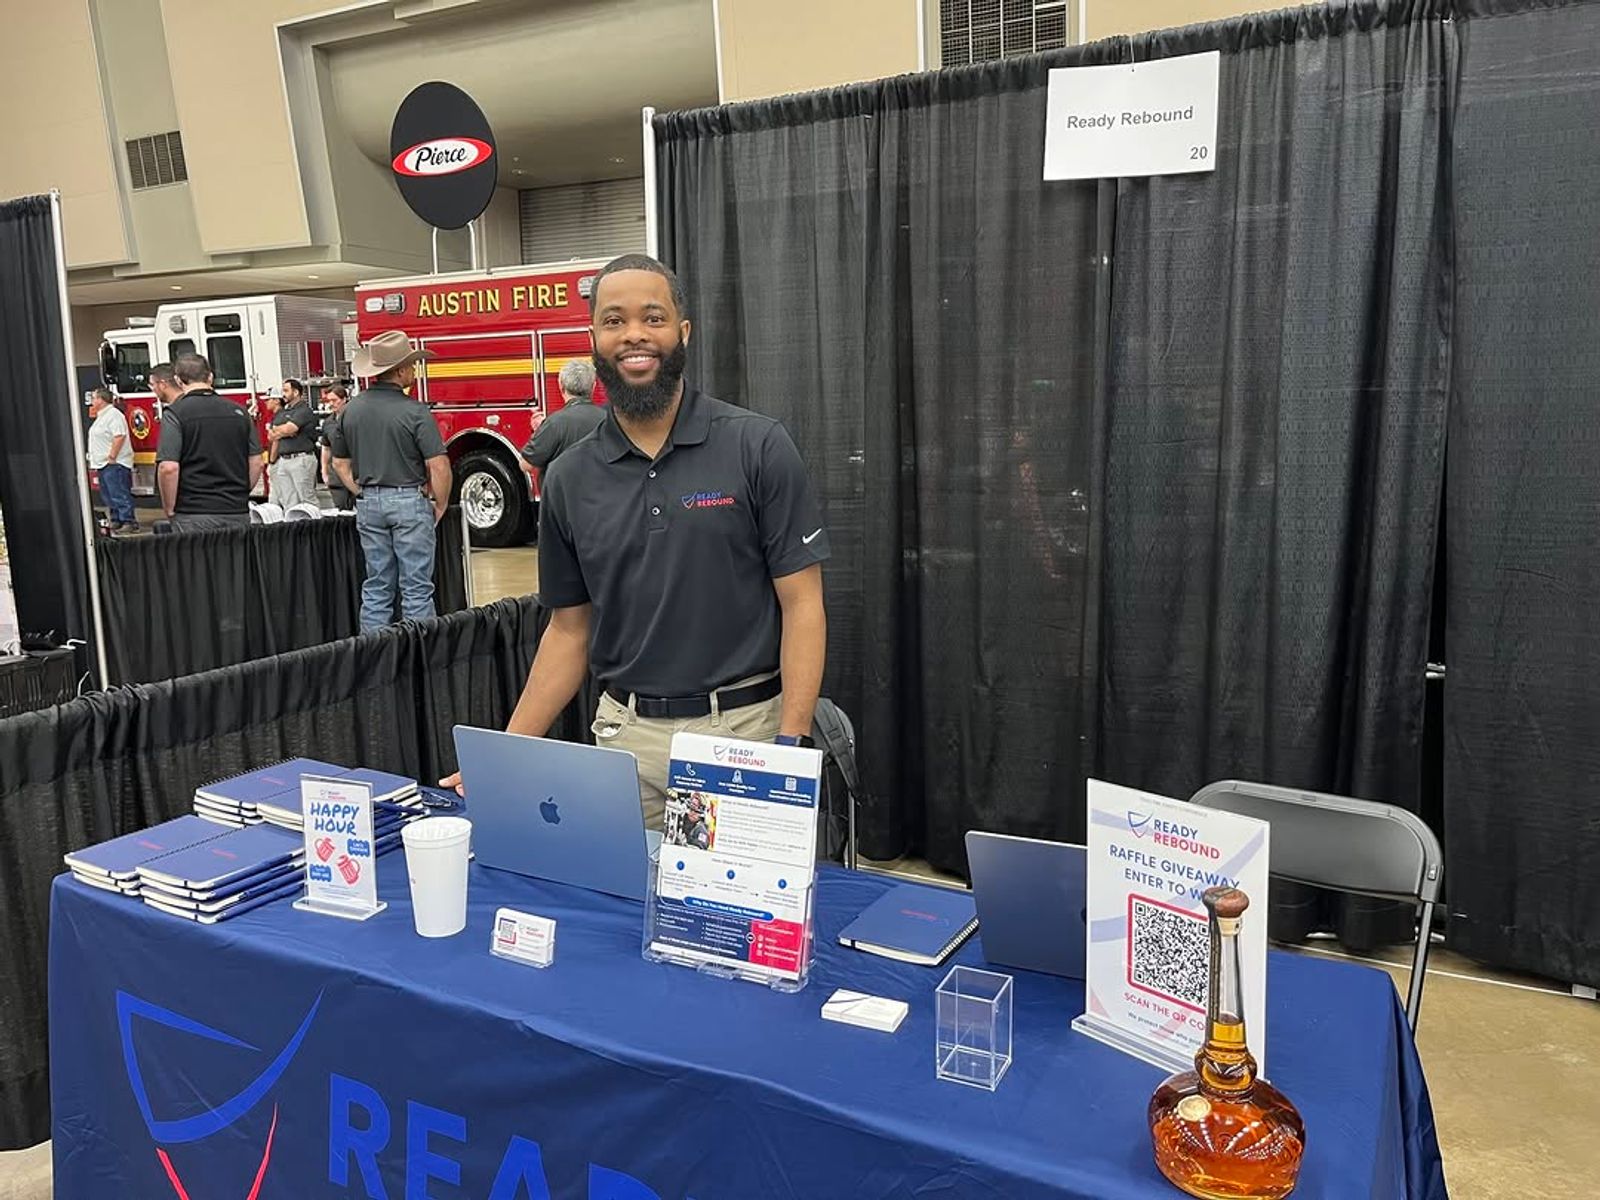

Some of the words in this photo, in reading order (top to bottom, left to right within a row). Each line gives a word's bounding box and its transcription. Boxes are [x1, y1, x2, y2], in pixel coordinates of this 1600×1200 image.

[1067, 113, 1116, 130] Ready
[1121, 106, 1194, 125] Rebound
[414, 146, 468, 171] Pierce
[1189, 146, 1208, 160] 20
[417, 289, 500, 318] AUSTIN
[512, 283, 569, 310] FIRE
[696, 490, 722, 499] READY
[696, 498, 736, 507] REBOUND
[727, 756, 766, 767] REBOUND
[728, 747, 754, 758] READY
[310, 802, 360, 820] HAPPY
[314, 818, 356, 836] HOUR
[1154, 819, 1198, 840] READY
[1154, 832, 1221, 860] REBOUND
[1109, 844, 1156, 868] RAFFLE
[1160, 860, 1240, 888] GIVEAWAY
[1124, 868, 1163, 890] ENTER
[1168, 880, 1186, 896] TO
[1123, 992, 1150, 1010] SCAN
[1152, 1004, 1170, 1017] THE
[1172, 1011, 1187, 1023] QR
[1189, 1018, 1205, 1031] CO
[328, 1071, 697, 1200] REA
